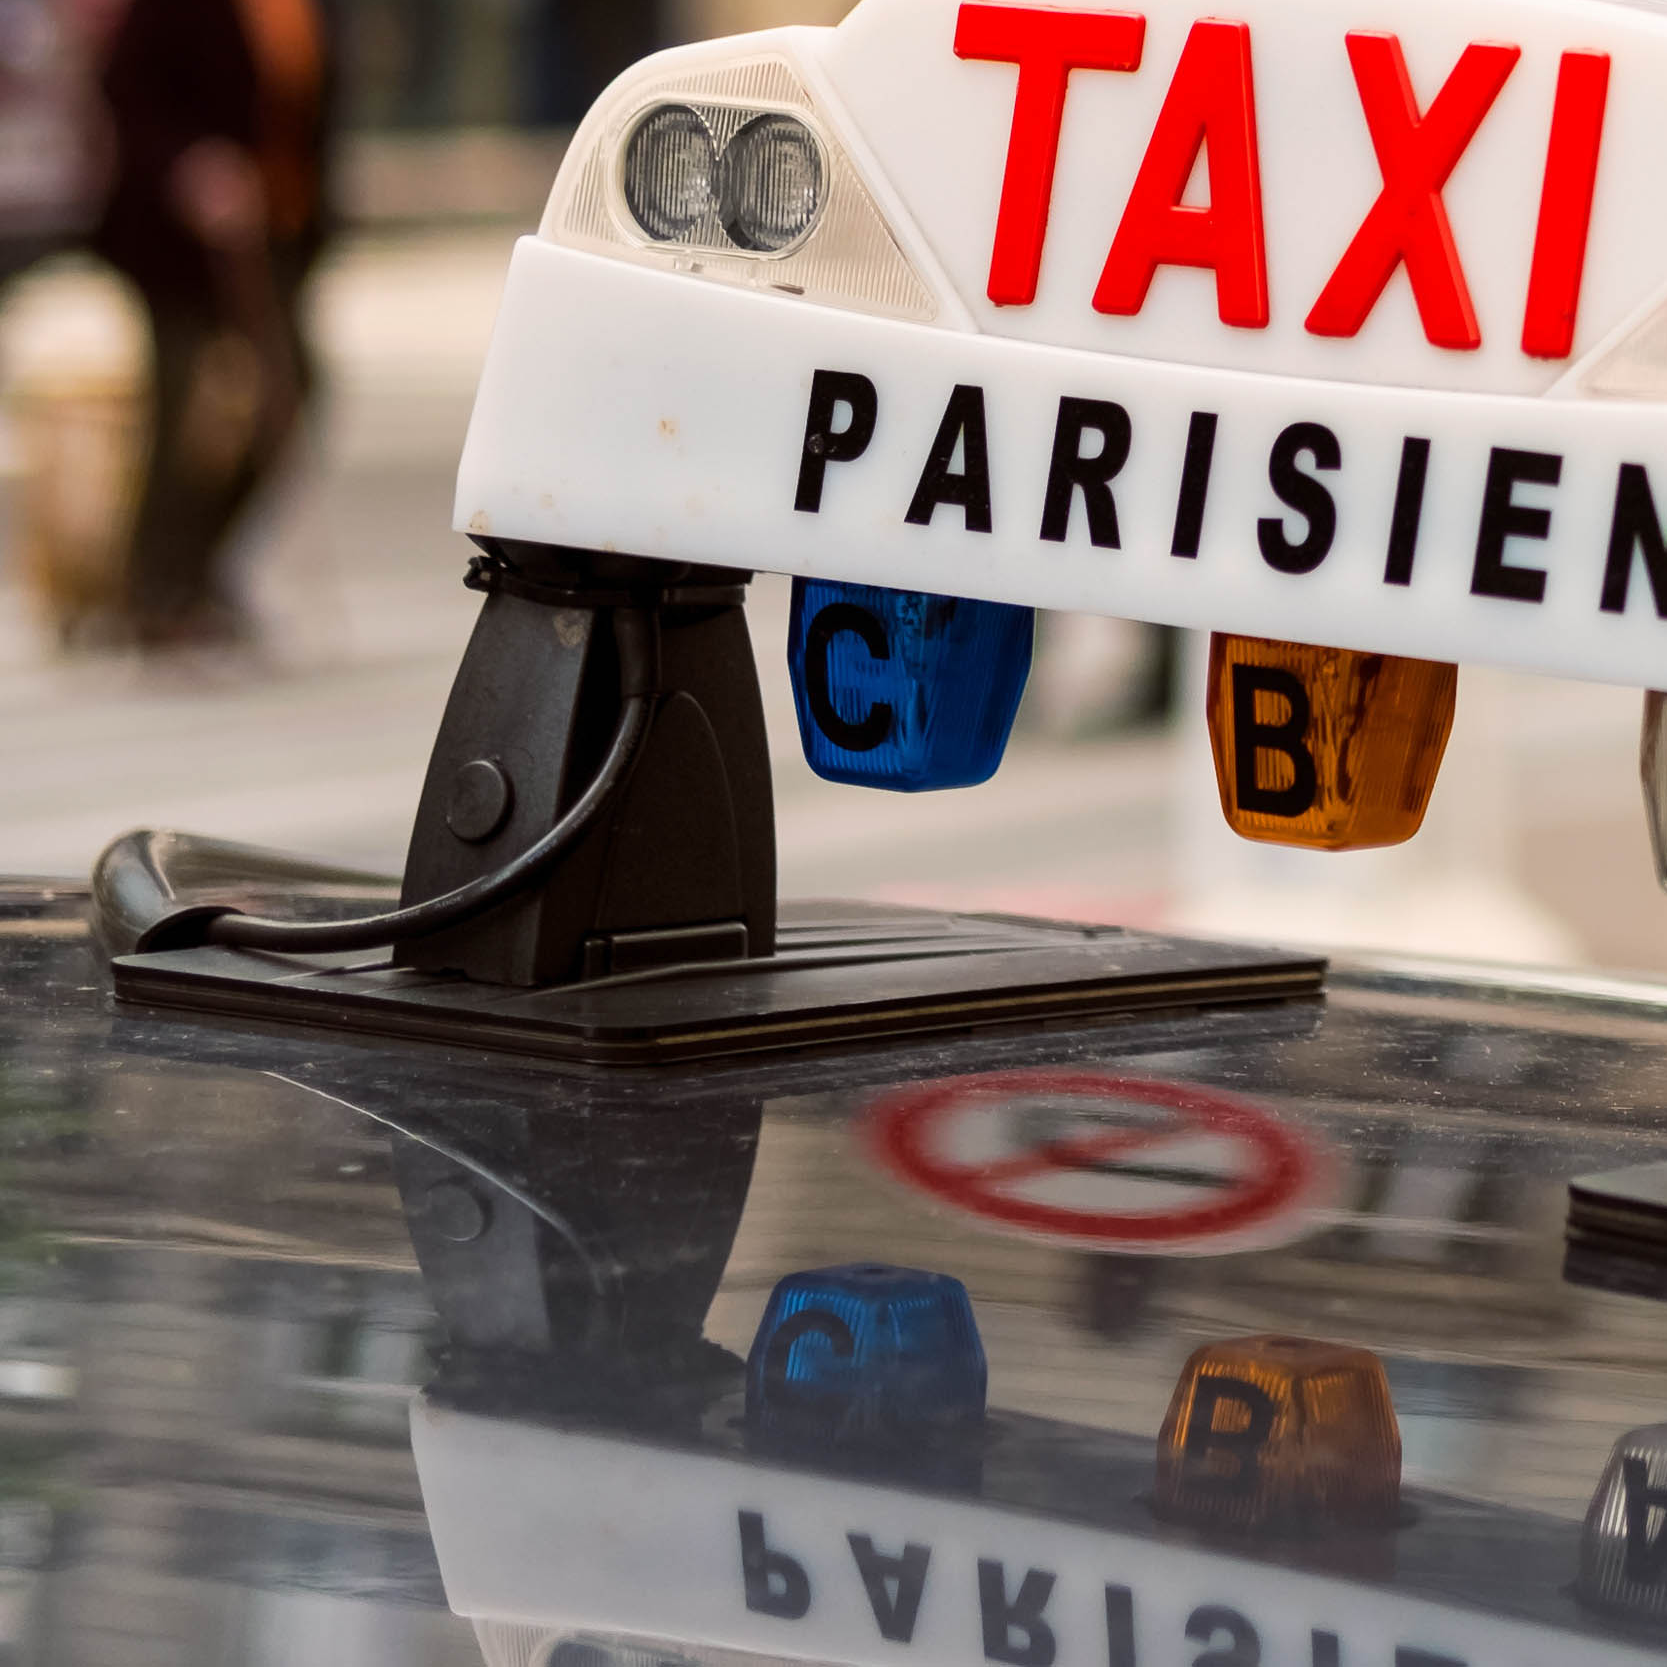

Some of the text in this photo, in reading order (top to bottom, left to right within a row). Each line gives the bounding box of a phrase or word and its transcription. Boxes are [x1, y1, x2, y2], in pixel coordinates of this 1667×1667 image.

[954, 2, 1611, 359] TAXI
[806, 603, 892, 752] C
[1232, 663, 1317, 817] B
